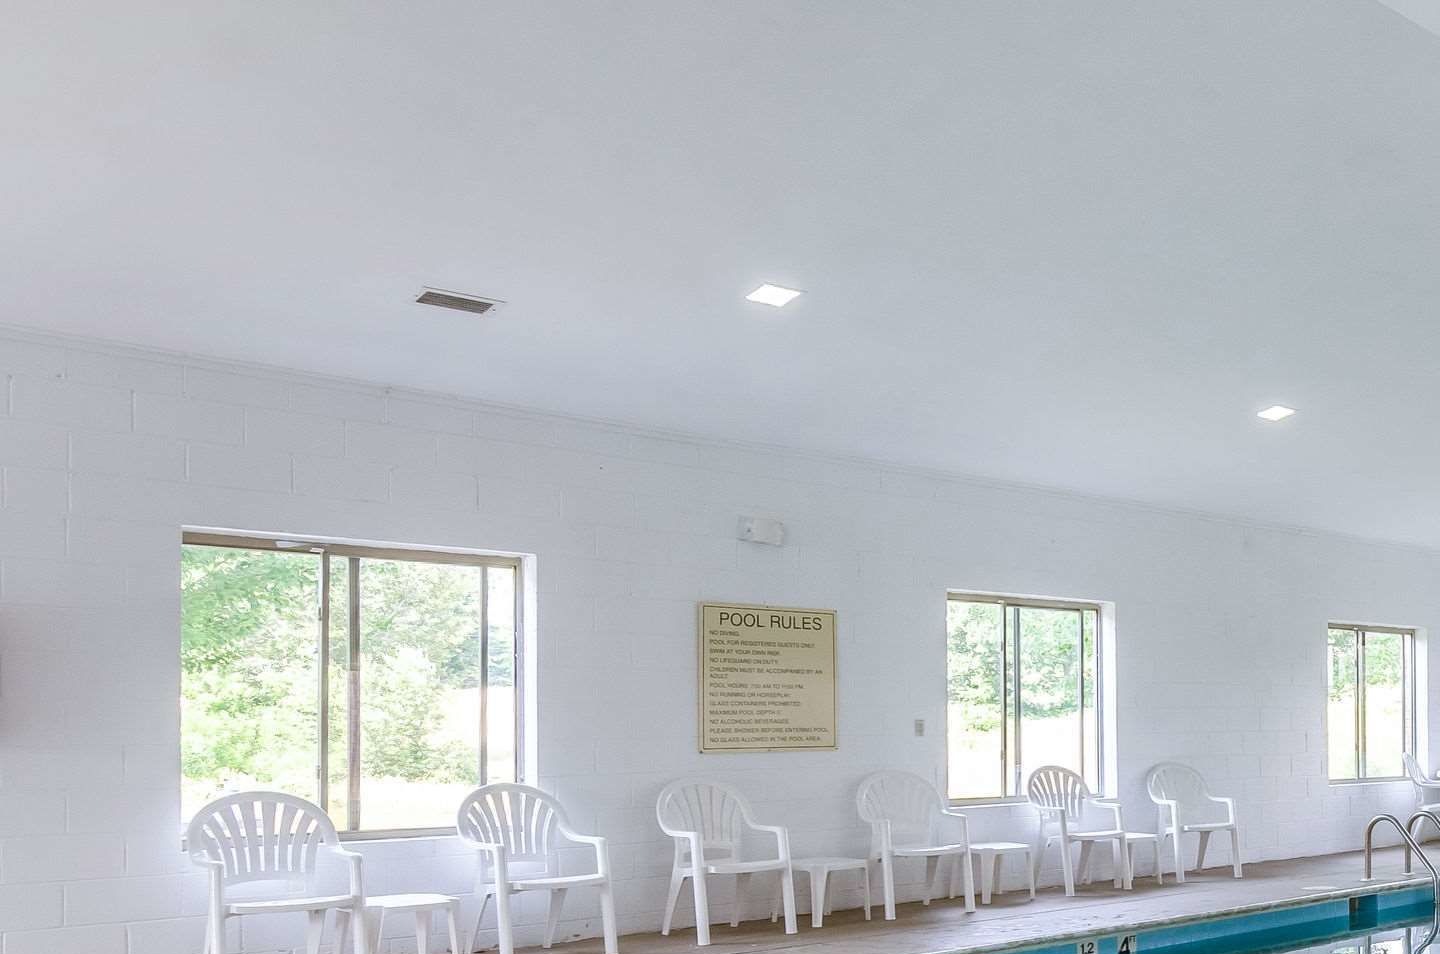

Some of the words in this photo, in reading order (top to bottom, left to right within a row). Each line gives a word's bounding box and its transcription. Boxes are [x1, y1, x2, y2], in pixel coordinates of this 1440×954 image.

[719, 612, 765, 628] POOL
[770, 615, 822, 631] RULES
[1080, 942, 1095, 954] 1.2
